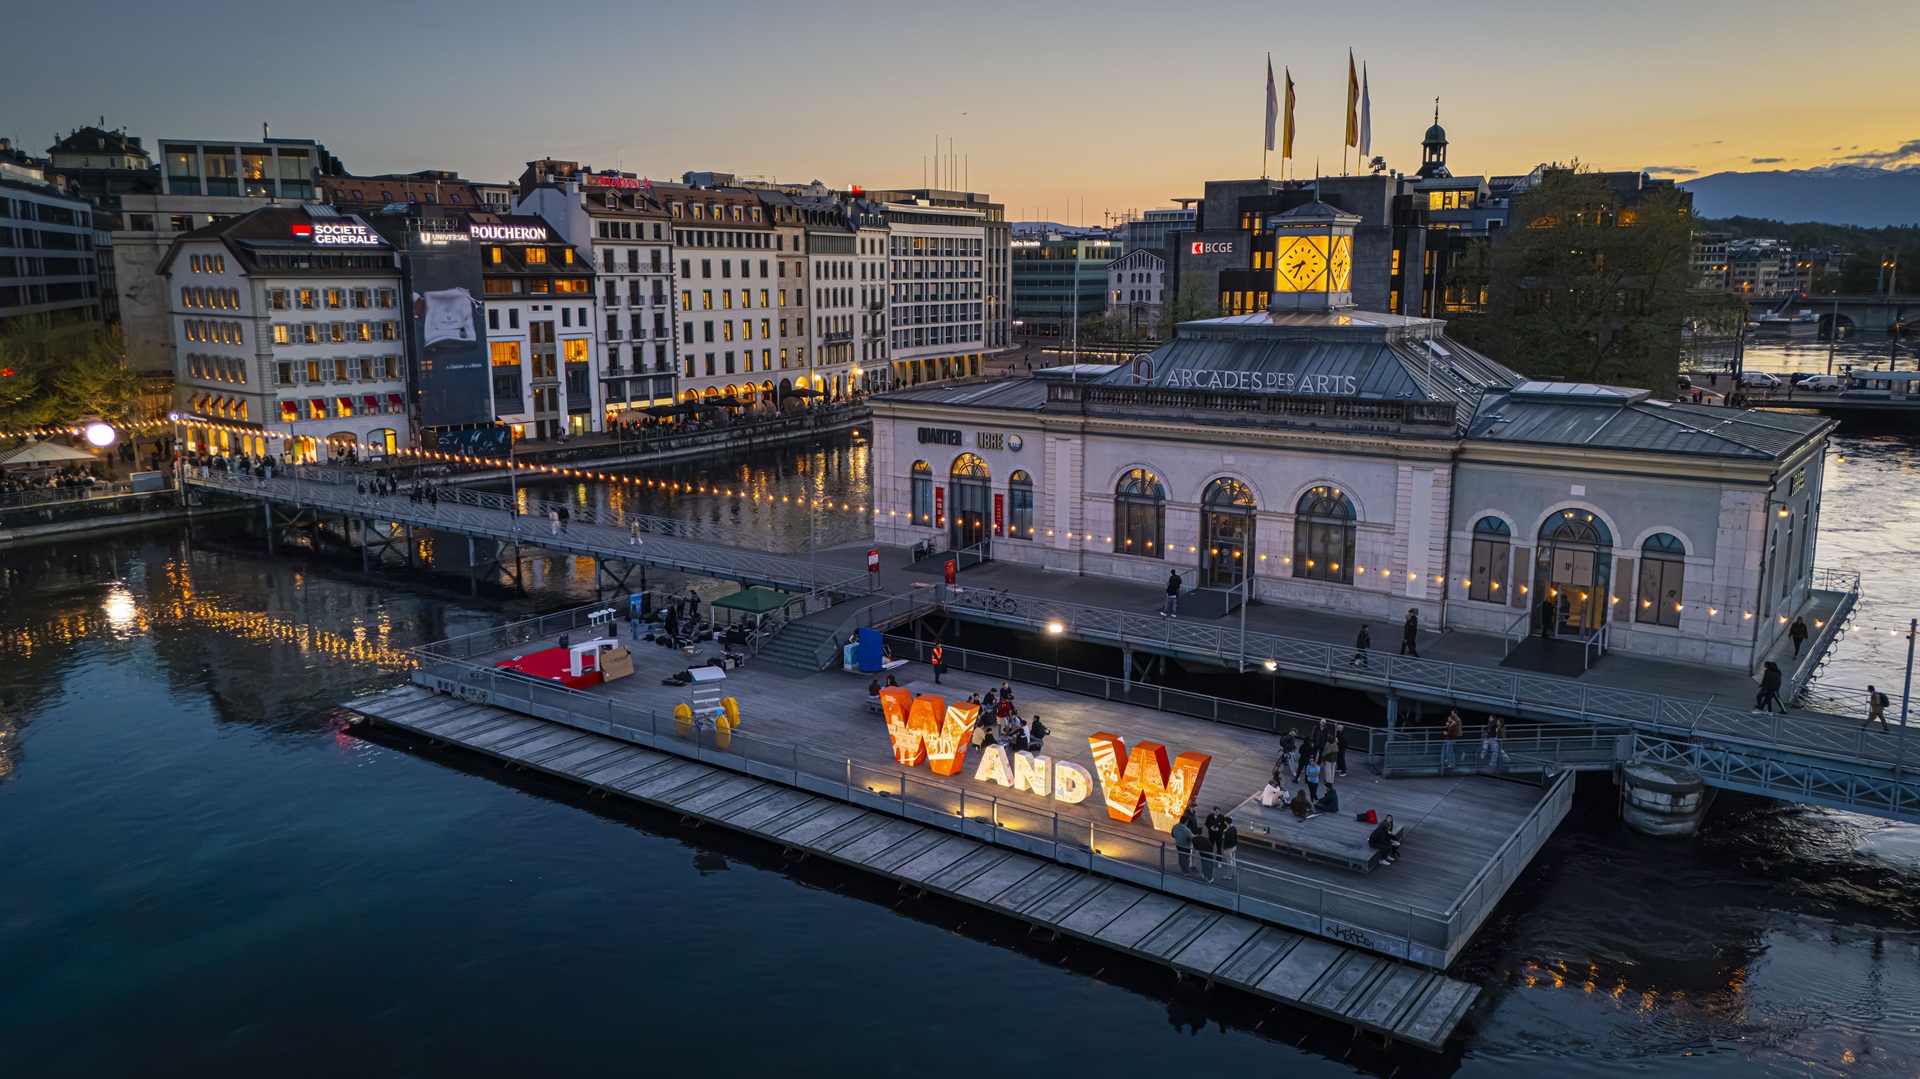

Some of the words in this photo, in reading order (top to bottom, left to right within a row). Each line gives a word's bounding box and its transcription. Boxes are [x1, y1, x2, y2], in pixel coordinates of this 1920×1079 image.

[314, 225, 367, 234] SOCIETE
[472, 226, 546, 239] BOUCHERON
[315, 235, 379, 244] GENERALE
[1205, 242, 1233, 253] BCGE
[1166, 369, 1263, 390] ARCADES
[1266, 372, 1295, 387] DES
[1299, 374, 1356, 395] ARTS
[917, 427, 962, 446] QUARTIER
[976, 432, 1003, 450] LIBRE
[879, 685, 980, 776] W
[974, 743, 1093, 804] AND
[1088, 731, 1212, 833] W
